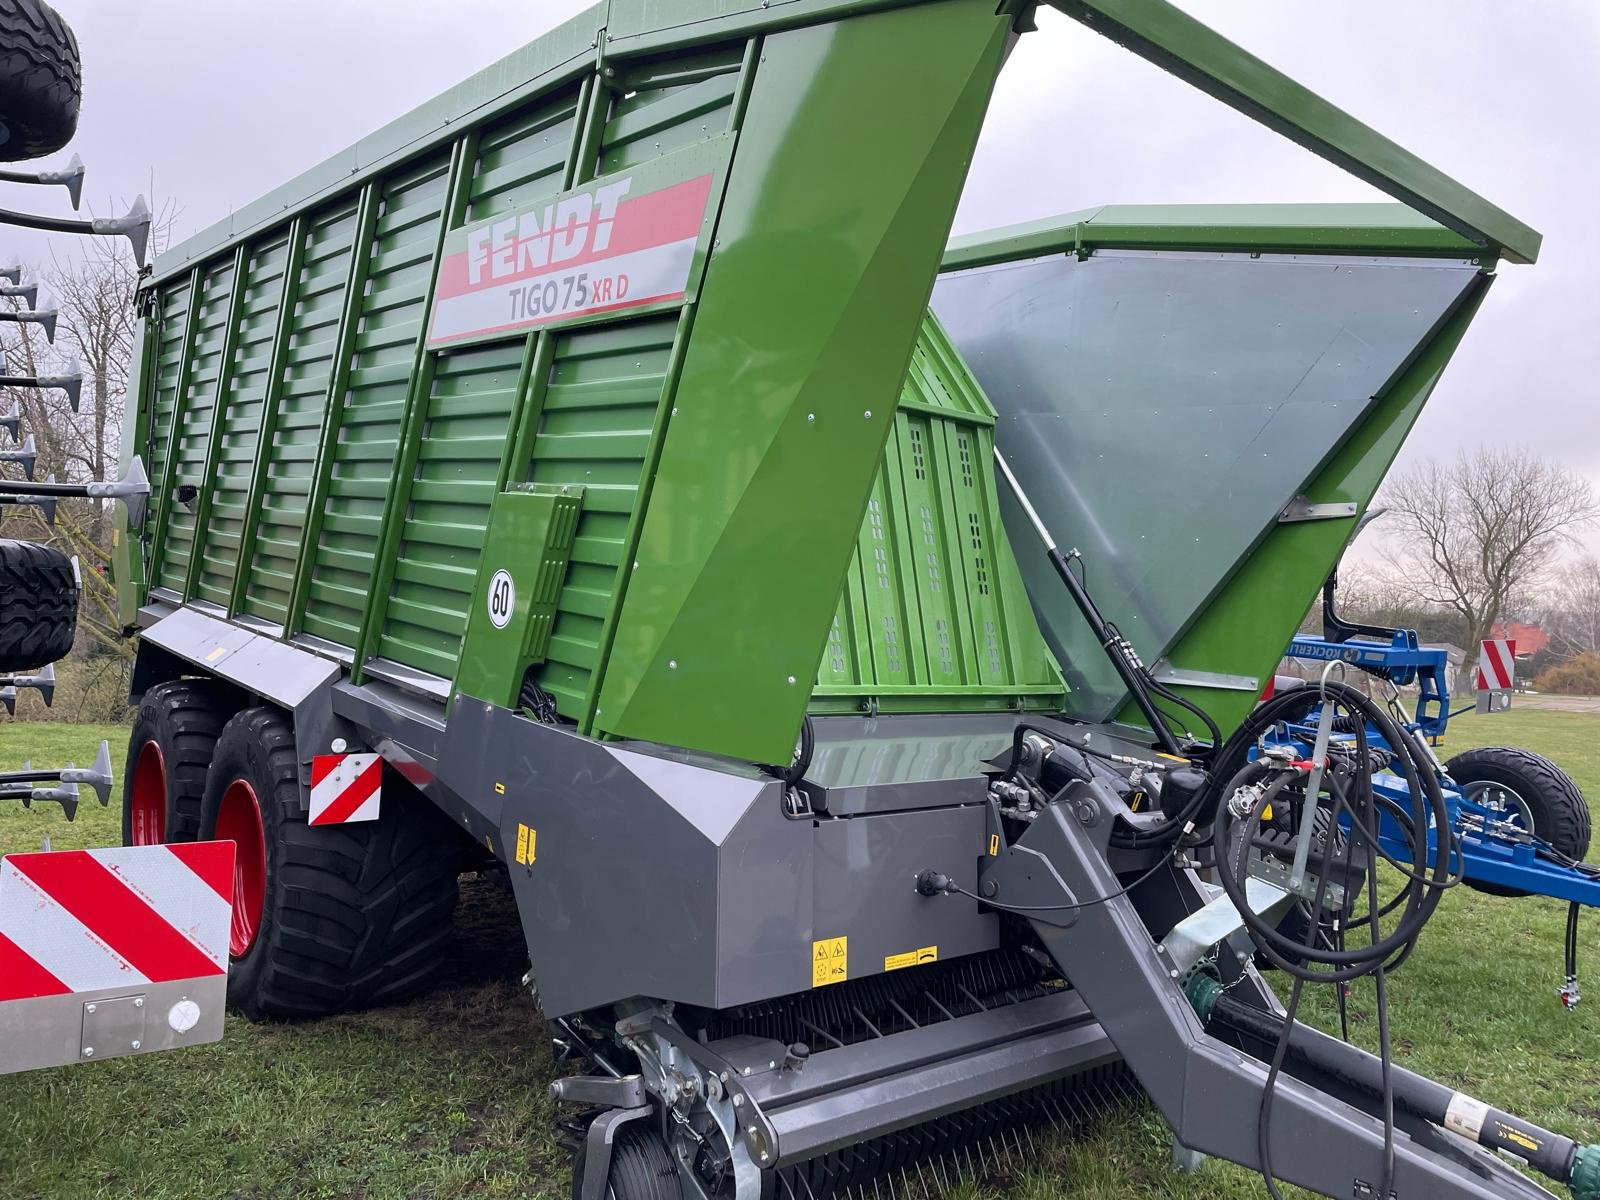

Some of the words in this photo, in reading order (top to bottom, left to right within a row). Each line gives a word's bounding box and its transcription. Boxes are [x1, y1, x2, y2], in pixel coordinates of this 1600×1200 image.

[467, 176, 632, 285] FENDT
[509, 280, 558, 320] TIGO
[562, 273, 588, 310] 75
[591, 277, 613, 304] XR
[616, 274, 629, 299] D
[492, 579, 509, 616] 60
